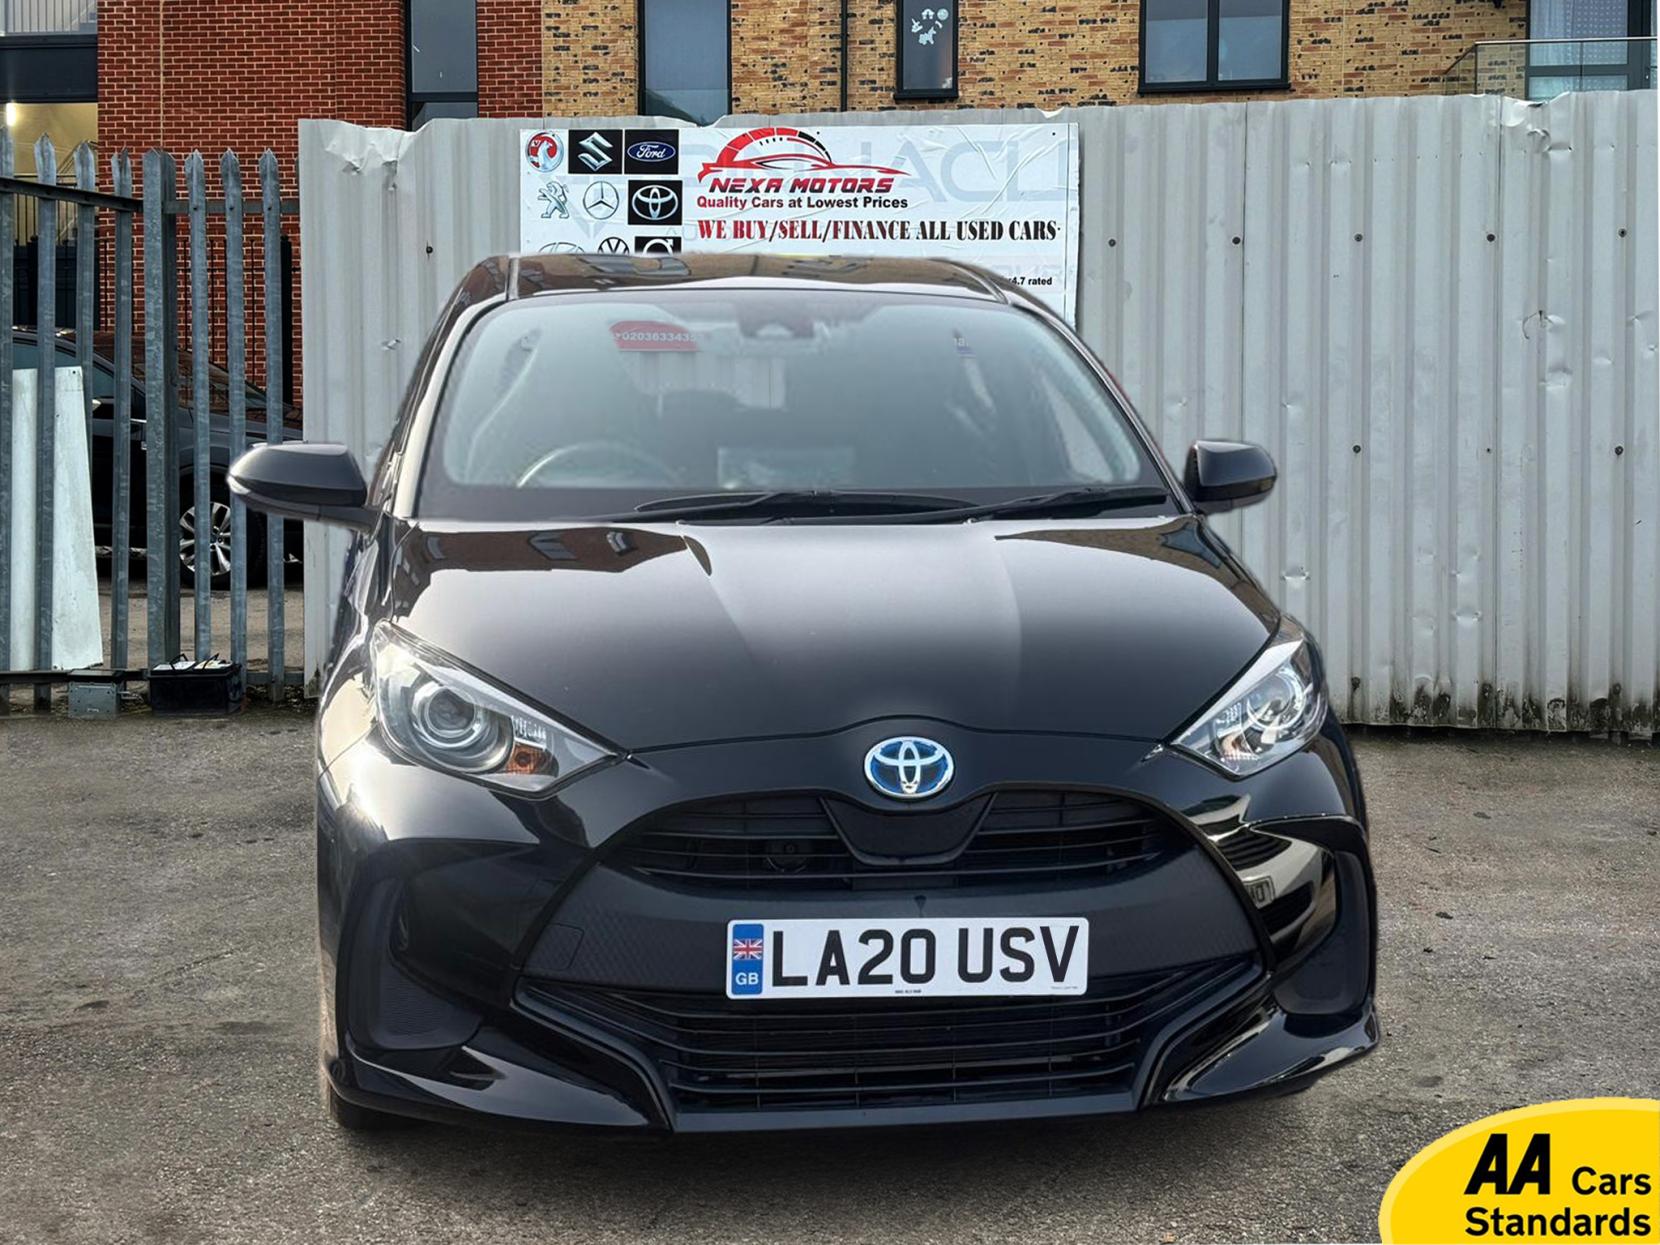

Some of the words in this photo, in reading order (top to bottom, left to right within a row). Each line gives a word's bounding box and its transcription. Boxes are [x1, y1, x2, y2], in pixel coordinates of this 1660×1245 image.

[636, 143, 666, 159] Ford
[709, 177, 784, 193] NEXA
[789, 177, 895, 193] MOTORS
[697, 195, 747, 210] Quality
[751, 195, 784, 208] Cars
[788, 196, 802, 208] at
[807, 196, 858, 208] Lowest
[863, 196, 908, 208] Prices
[697, 219, 727, 239] WE
[916, 220, 951, 240] ALL
[957, 220, 1004, 241] USED
[1008, 220, 1057, 241] CARS
[1027, 277, 1053, 286] rated
[772, 928, 937, 987] LA20
[957, 925, 1080, 983] USV
[735, 972, 760, 985] GB
